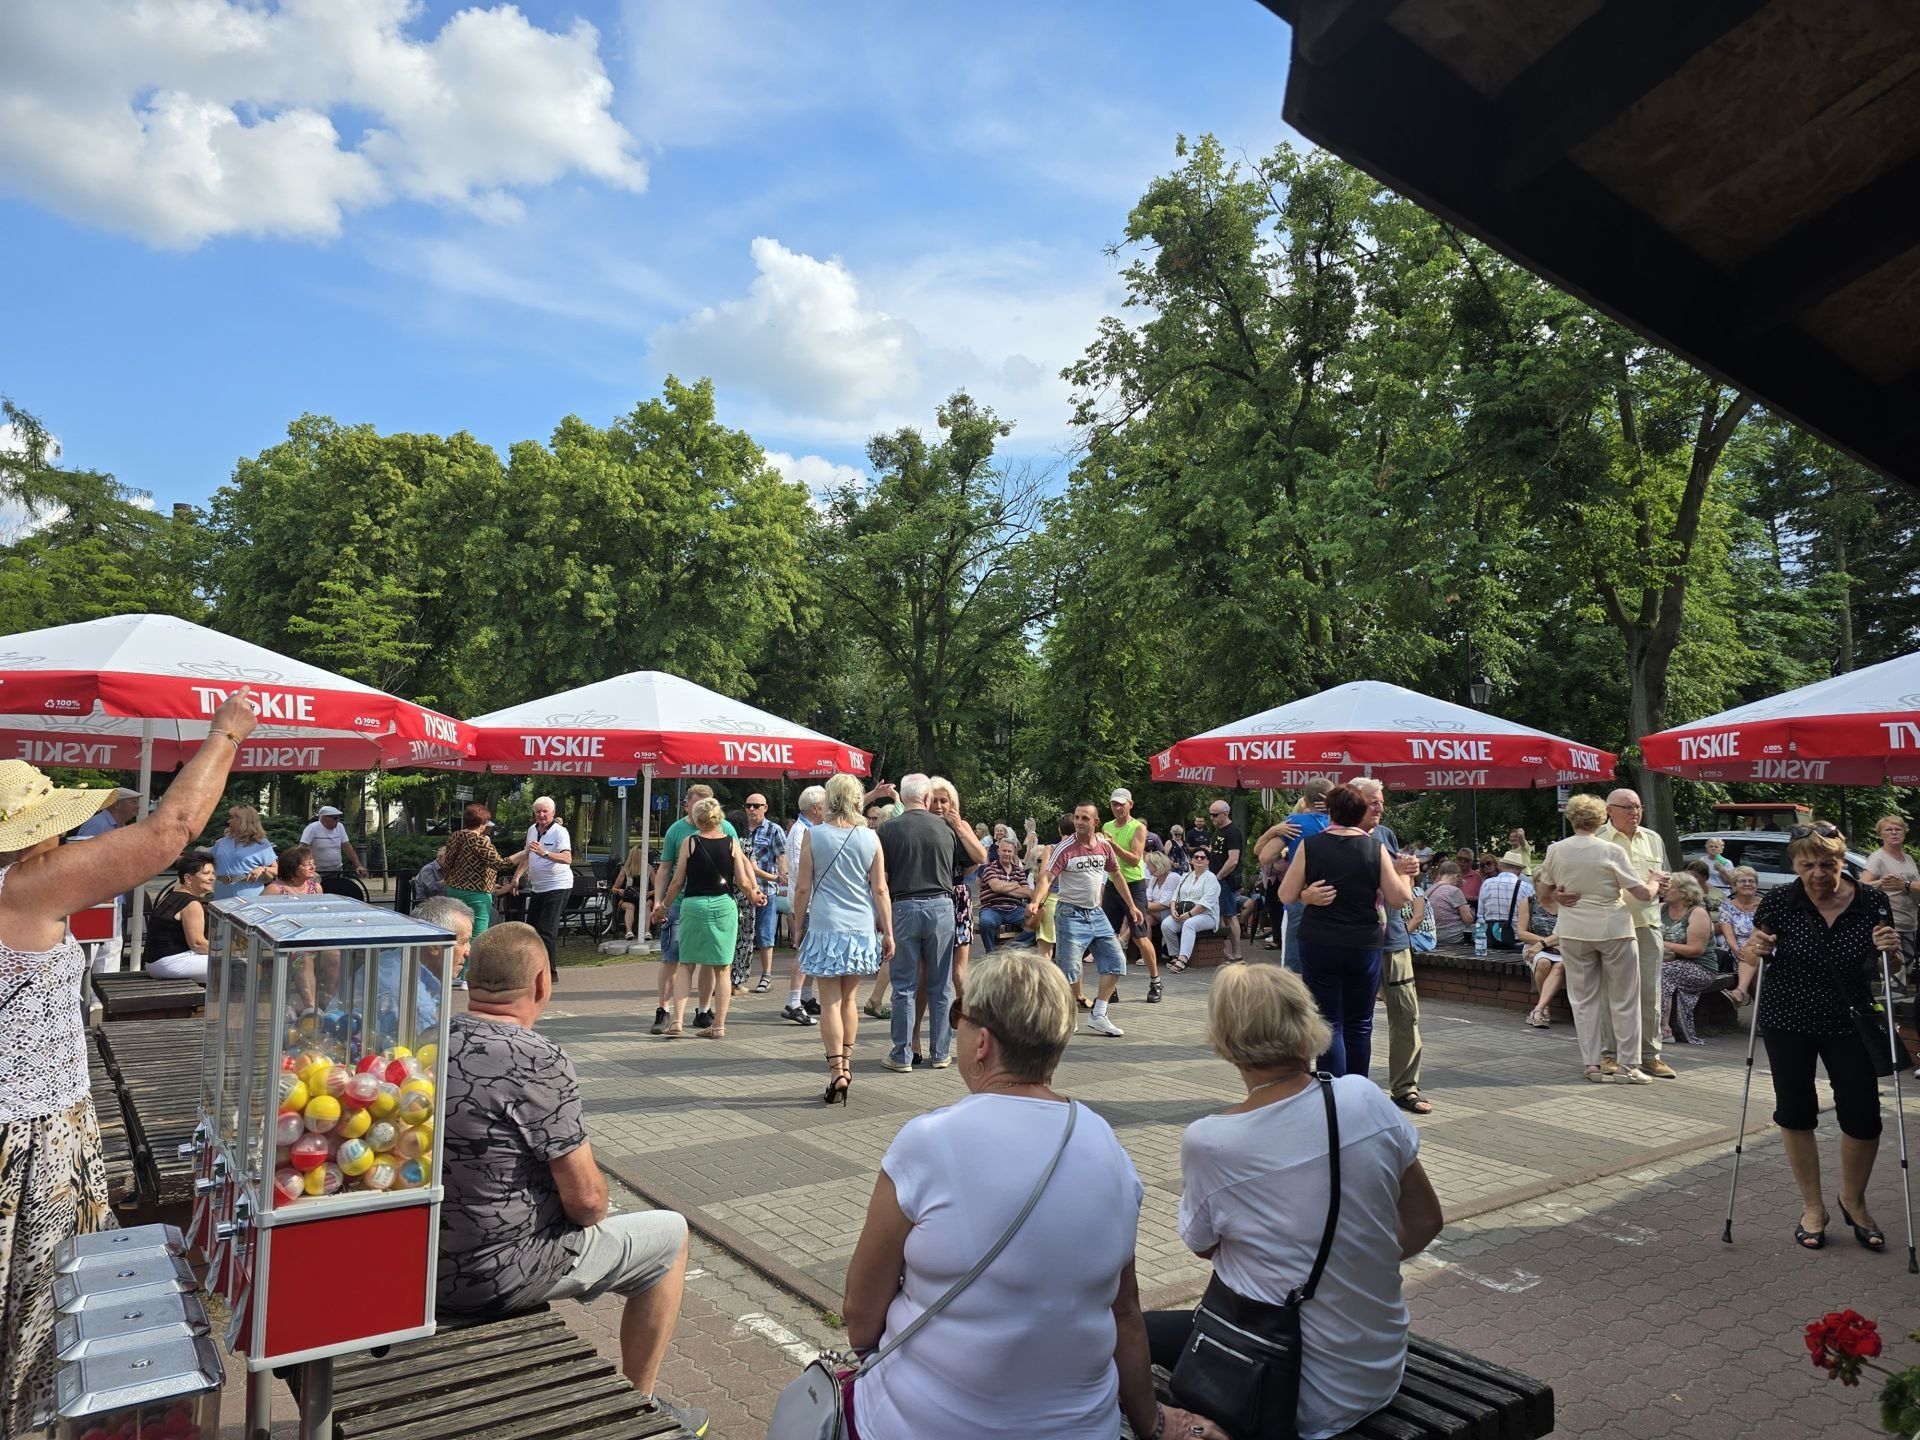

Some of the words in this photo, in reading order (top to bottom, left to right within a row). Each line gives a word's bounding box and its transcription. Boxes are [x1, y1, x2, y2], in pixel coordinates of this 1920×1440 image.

[422, 713, 458, 744] TYSKIE
[520, 736, 605, 757] TYSKIE
[719, 741, 794, 764] TYSKIE
[1225, 740, 1296, 761] TYSKIE
[1406, 739, 1493, 761] TYSKIE
[1678, 732, 1740, 760] TYSKIE
[1569, 748, 1600, 772] TYSKIE
